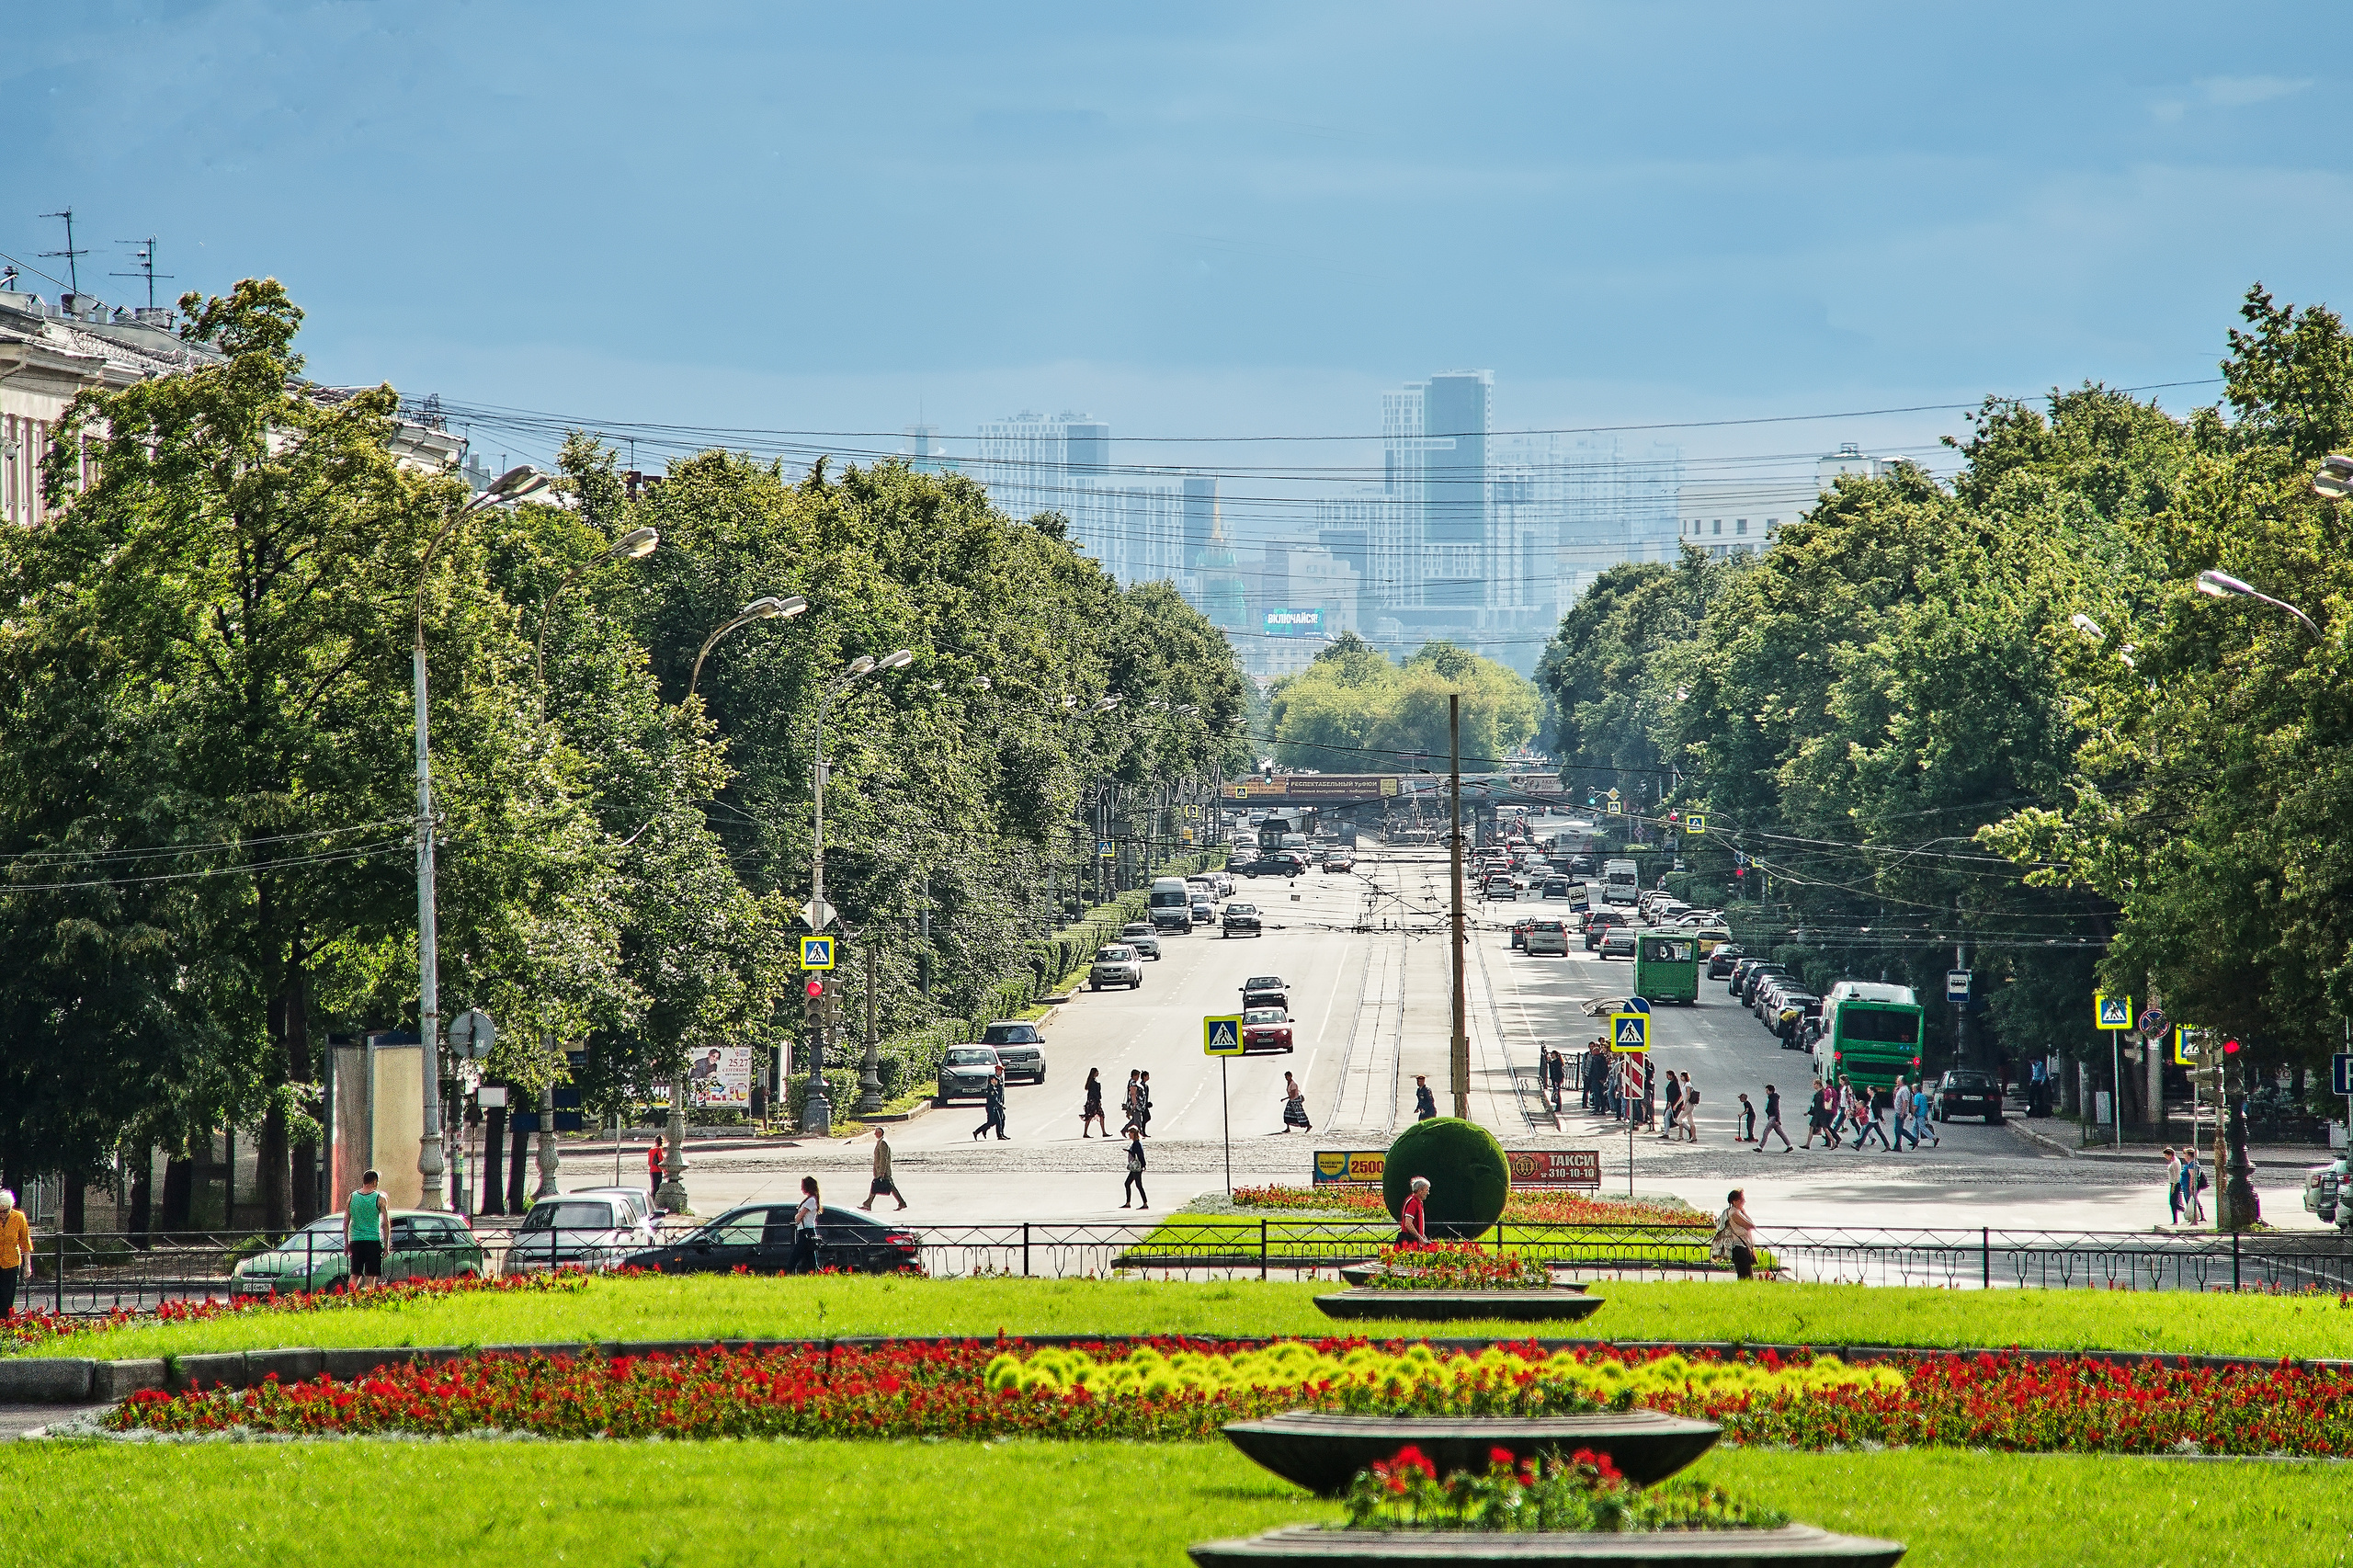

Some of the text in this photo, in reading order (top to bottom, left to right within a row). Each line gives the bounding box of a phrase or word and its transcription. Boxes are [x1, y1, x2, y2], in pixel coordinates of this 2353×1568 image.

[1267, 612, 1319, 624] ВКЛЮЧАЙСЯ!
[1548, 1154, 1596, 1166] ТАКСИ
[1351, 1160, 1385, 1174] 2500
[1549, 1168, 1595, 1178] 310-10-10
